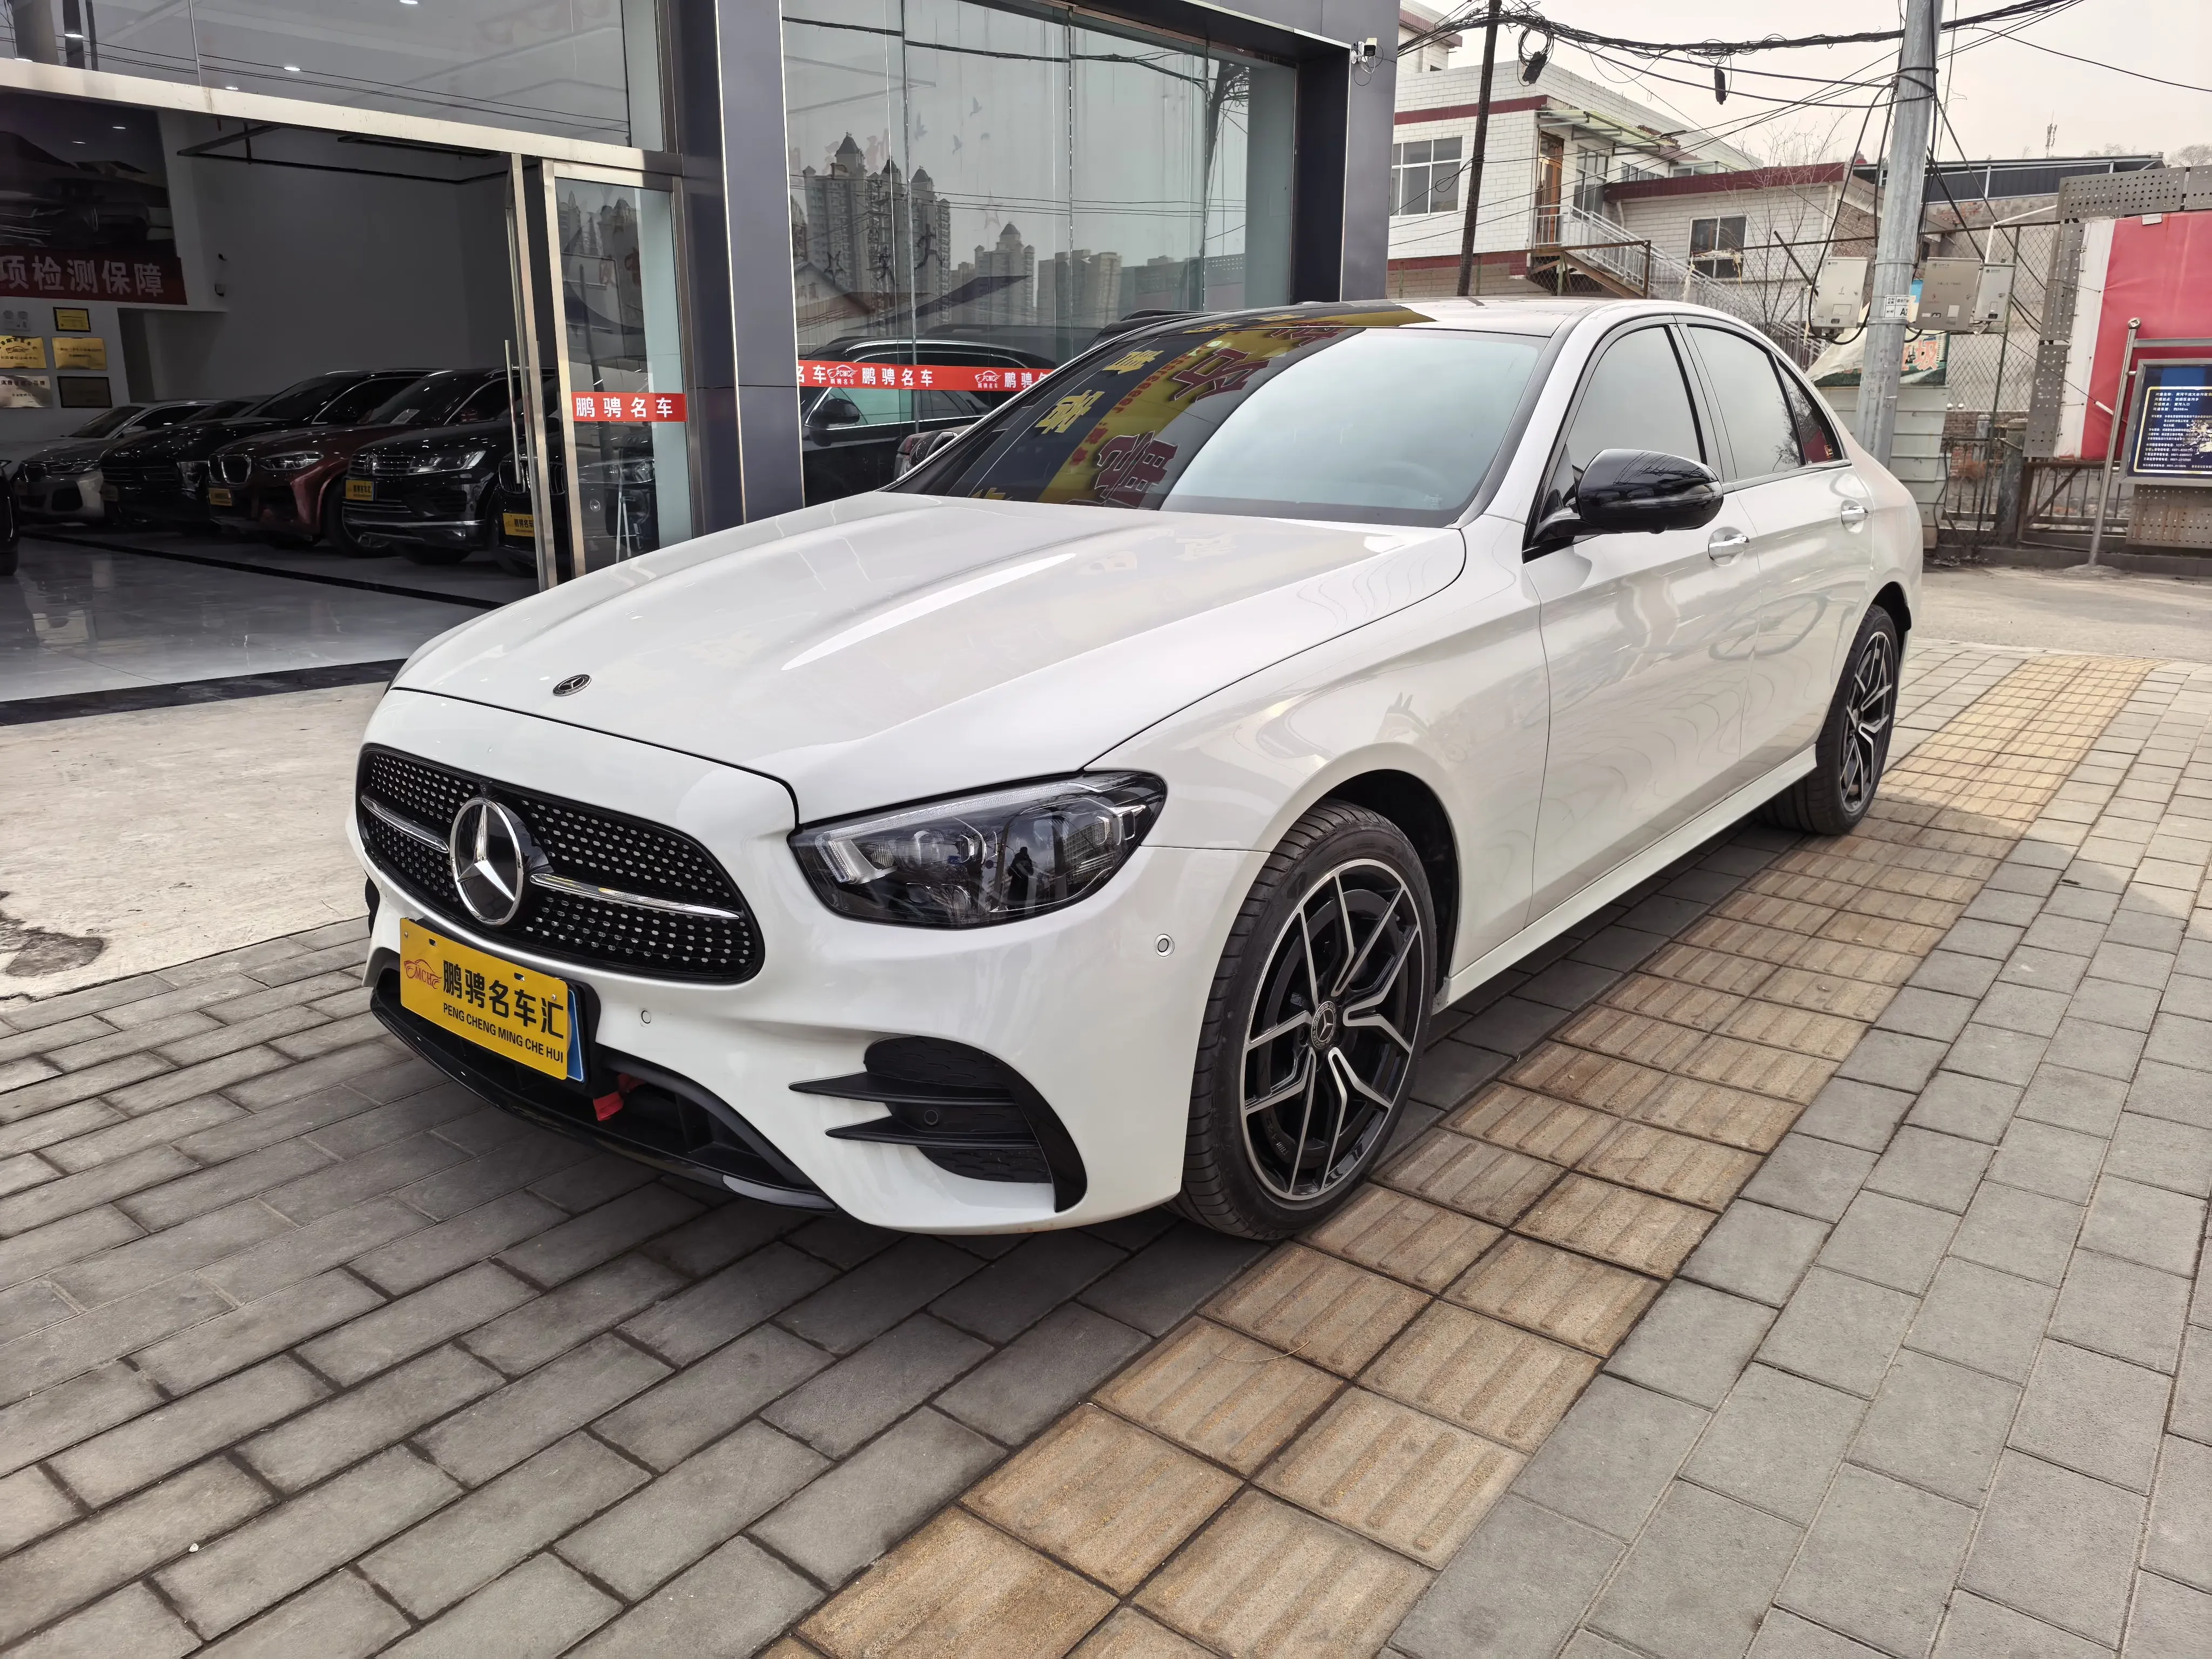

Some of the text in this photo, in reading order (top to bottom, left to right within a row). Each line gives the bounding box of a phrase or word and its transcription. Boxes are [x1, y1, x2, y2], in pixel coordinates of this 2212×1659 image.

[862, 367, 933, 387] 鹏骋名车
[576, 396, 673, 418] 鹏骋名车
[443, 960, 564, 1039] 鹏骋名车汇
[443, 1002, 563, 1063] PENG CHENG MING CHE HUI
